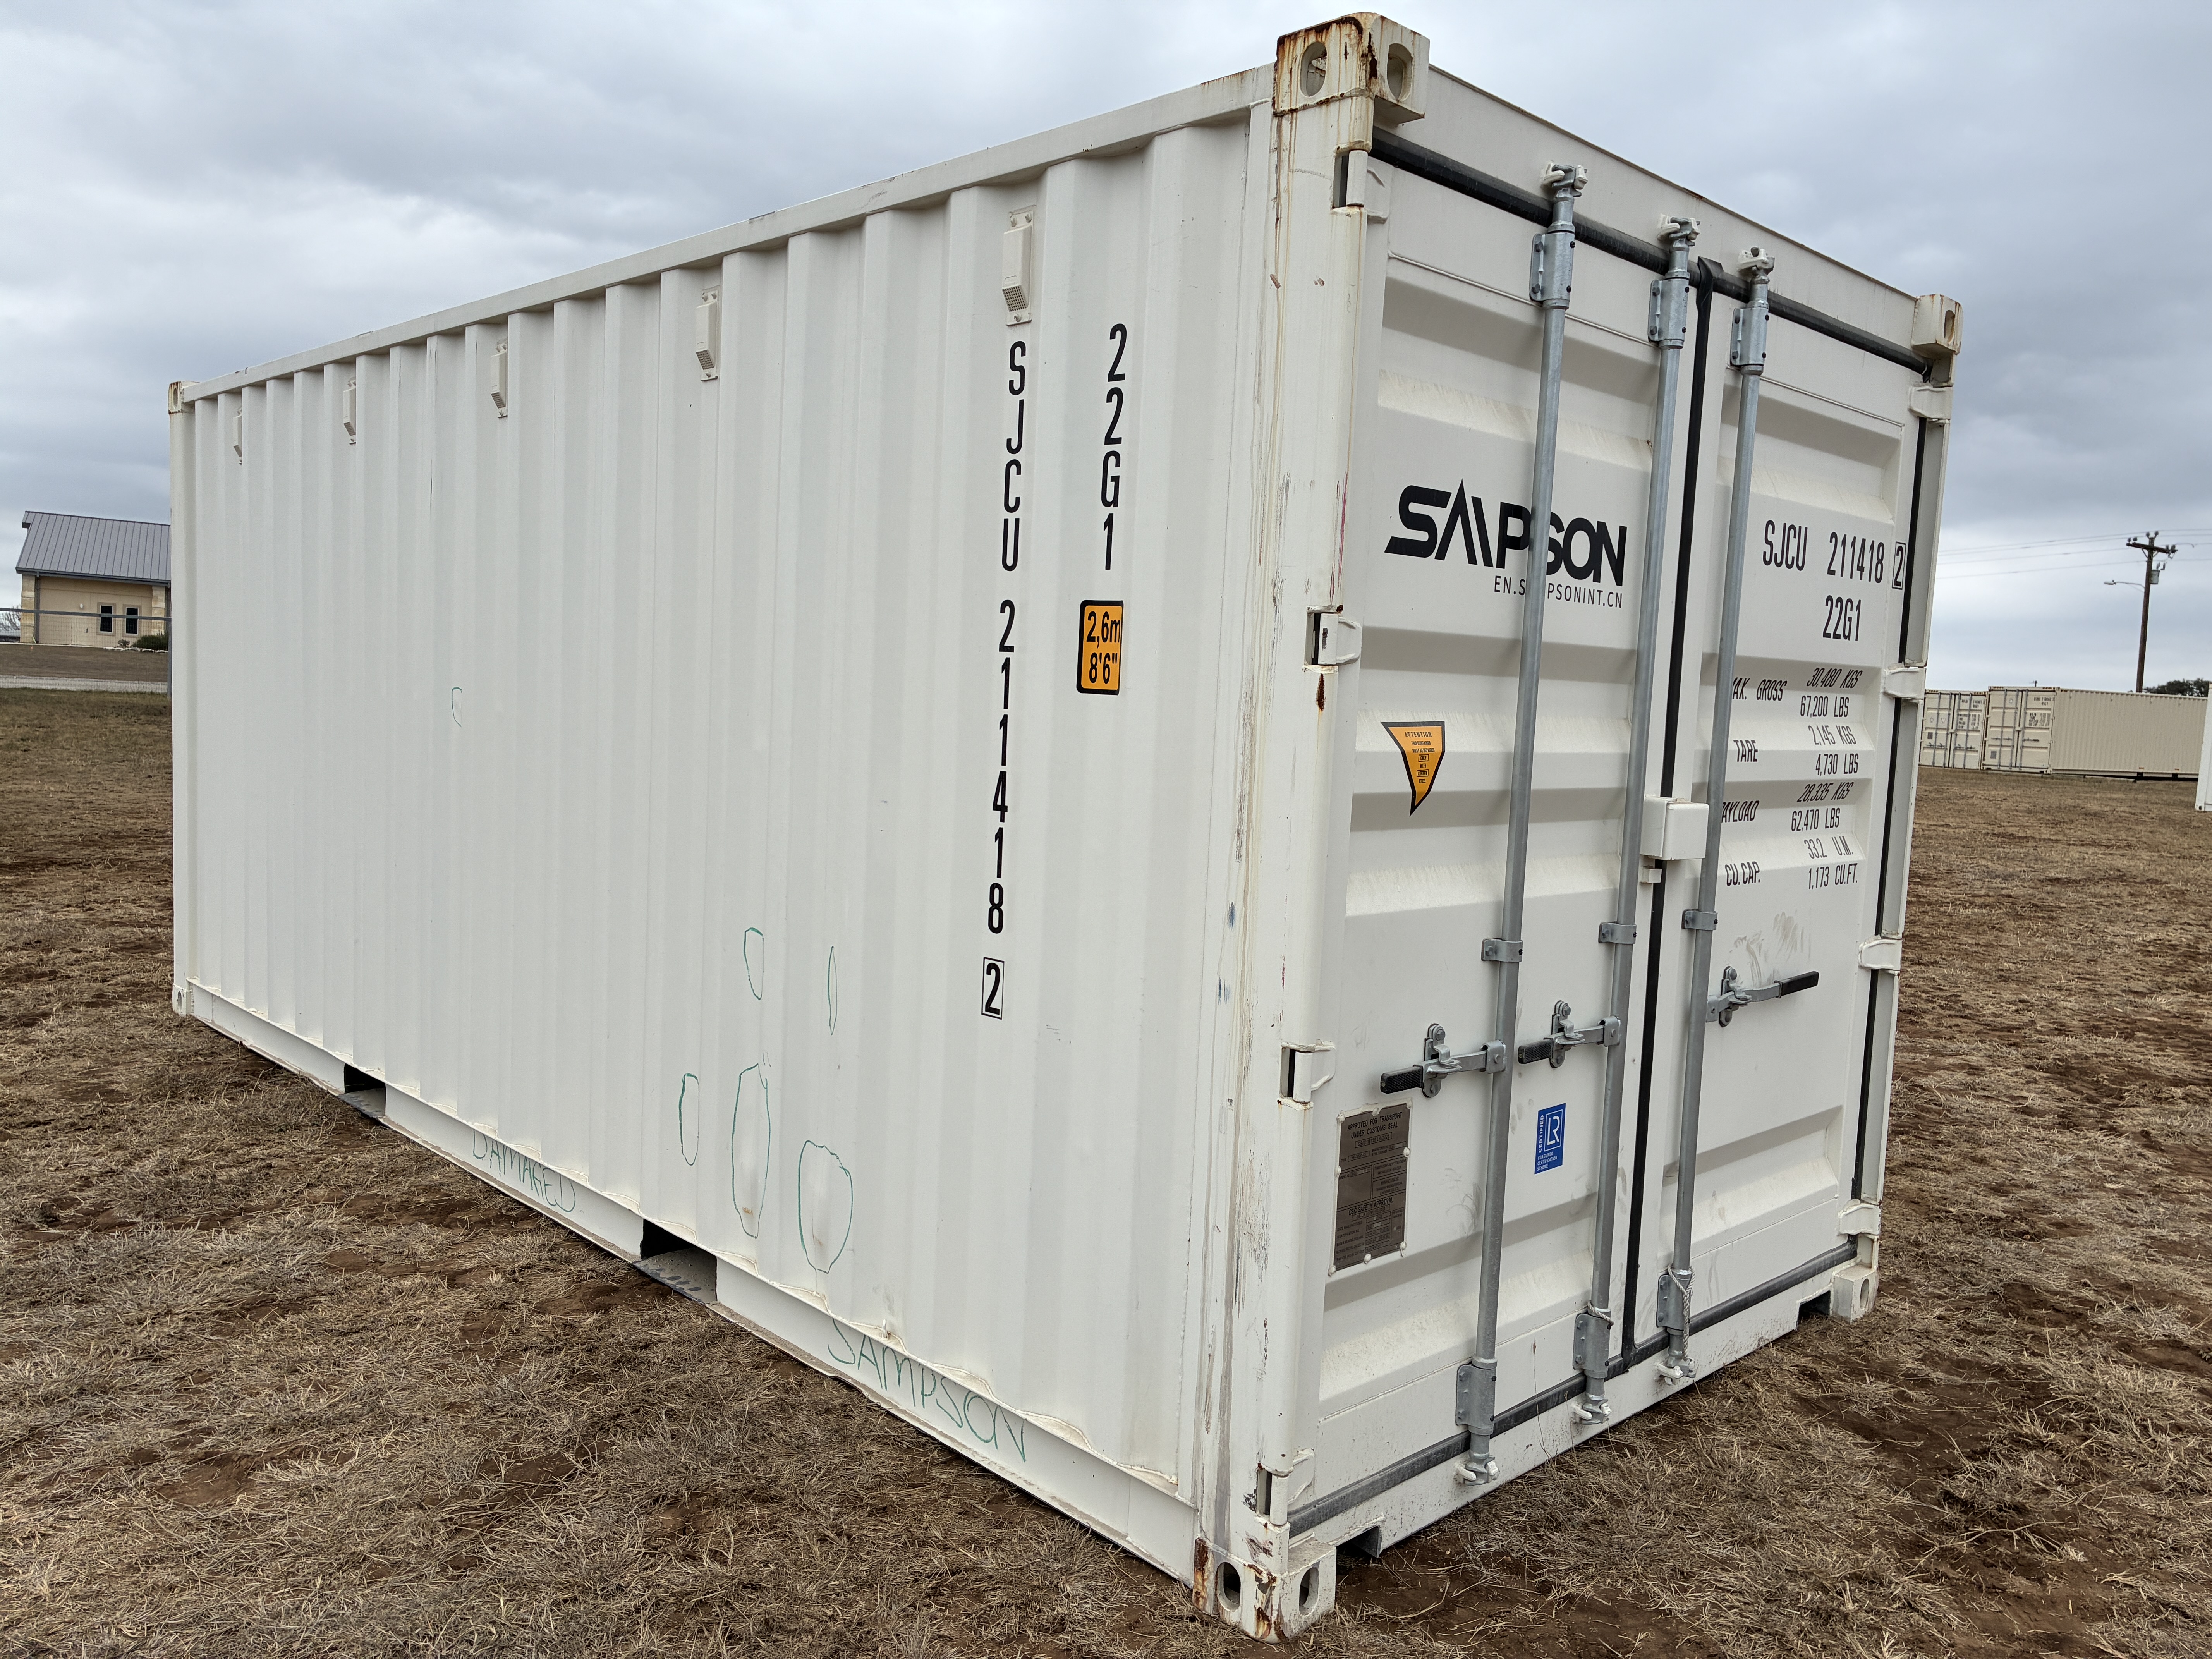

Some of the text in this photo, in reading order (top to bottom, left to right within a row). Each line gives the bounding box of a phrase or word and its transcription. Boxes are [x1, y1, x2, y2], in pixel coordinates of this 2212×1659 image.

[1101, 323, 1127, 570] 22G1
[1763, 520, 1904, 586] SJCU 211418 2
[1494, 575, 1622, 608] EN.SPSONINT.CN
[1086, 611, 1120, 649] 2,6m
[1823, 595, 1861, 642] 22G1
[984, 341, 1026, 1015] SJCU 211418 2
[1089, 652, 1118, 684] 8'6"
[1806, 667, 1863, 689] 30,480 KGS
[1733, 677, 1788, 701] AX. GROSS
[1800, 696, 1849, 718] 67,200 LBS
[1808, 725, 1856, 745] 2,145 KGS
[1733, 740, 1758, 762] TARE
[1815, 753, 1859, 776] 4,730 LBS
[1797, 782, 1854, 802] 28,335 KGS
[1791, 807, 1840, 832] 62,470 LBS
[1804, 838, 1827, 859] 33.2
[1725, 861, 1760, 886] CU.CAP.
[1808, 863, 1858, 890] 1,173 CU.FT.
[1347, 1120, 1368, 1131] APPROVED
[1380, 1112, 1402, 1123] TRANSPORT
[1351, 1130, 1365, 1139] UNDER
[1367, 1124, 1386, 1135] CUSTOMS
[1537, 1156, 1557, 1166] CERTIFICATION
[1538, 1151, 1553, 1160] CONTAINER
[1358, 1203, 1373, 1212] SAFETY
[1374, 1197, 1393, 1207] APPROVAL
[828, 1318, 1027, 1462] SAMPSON
